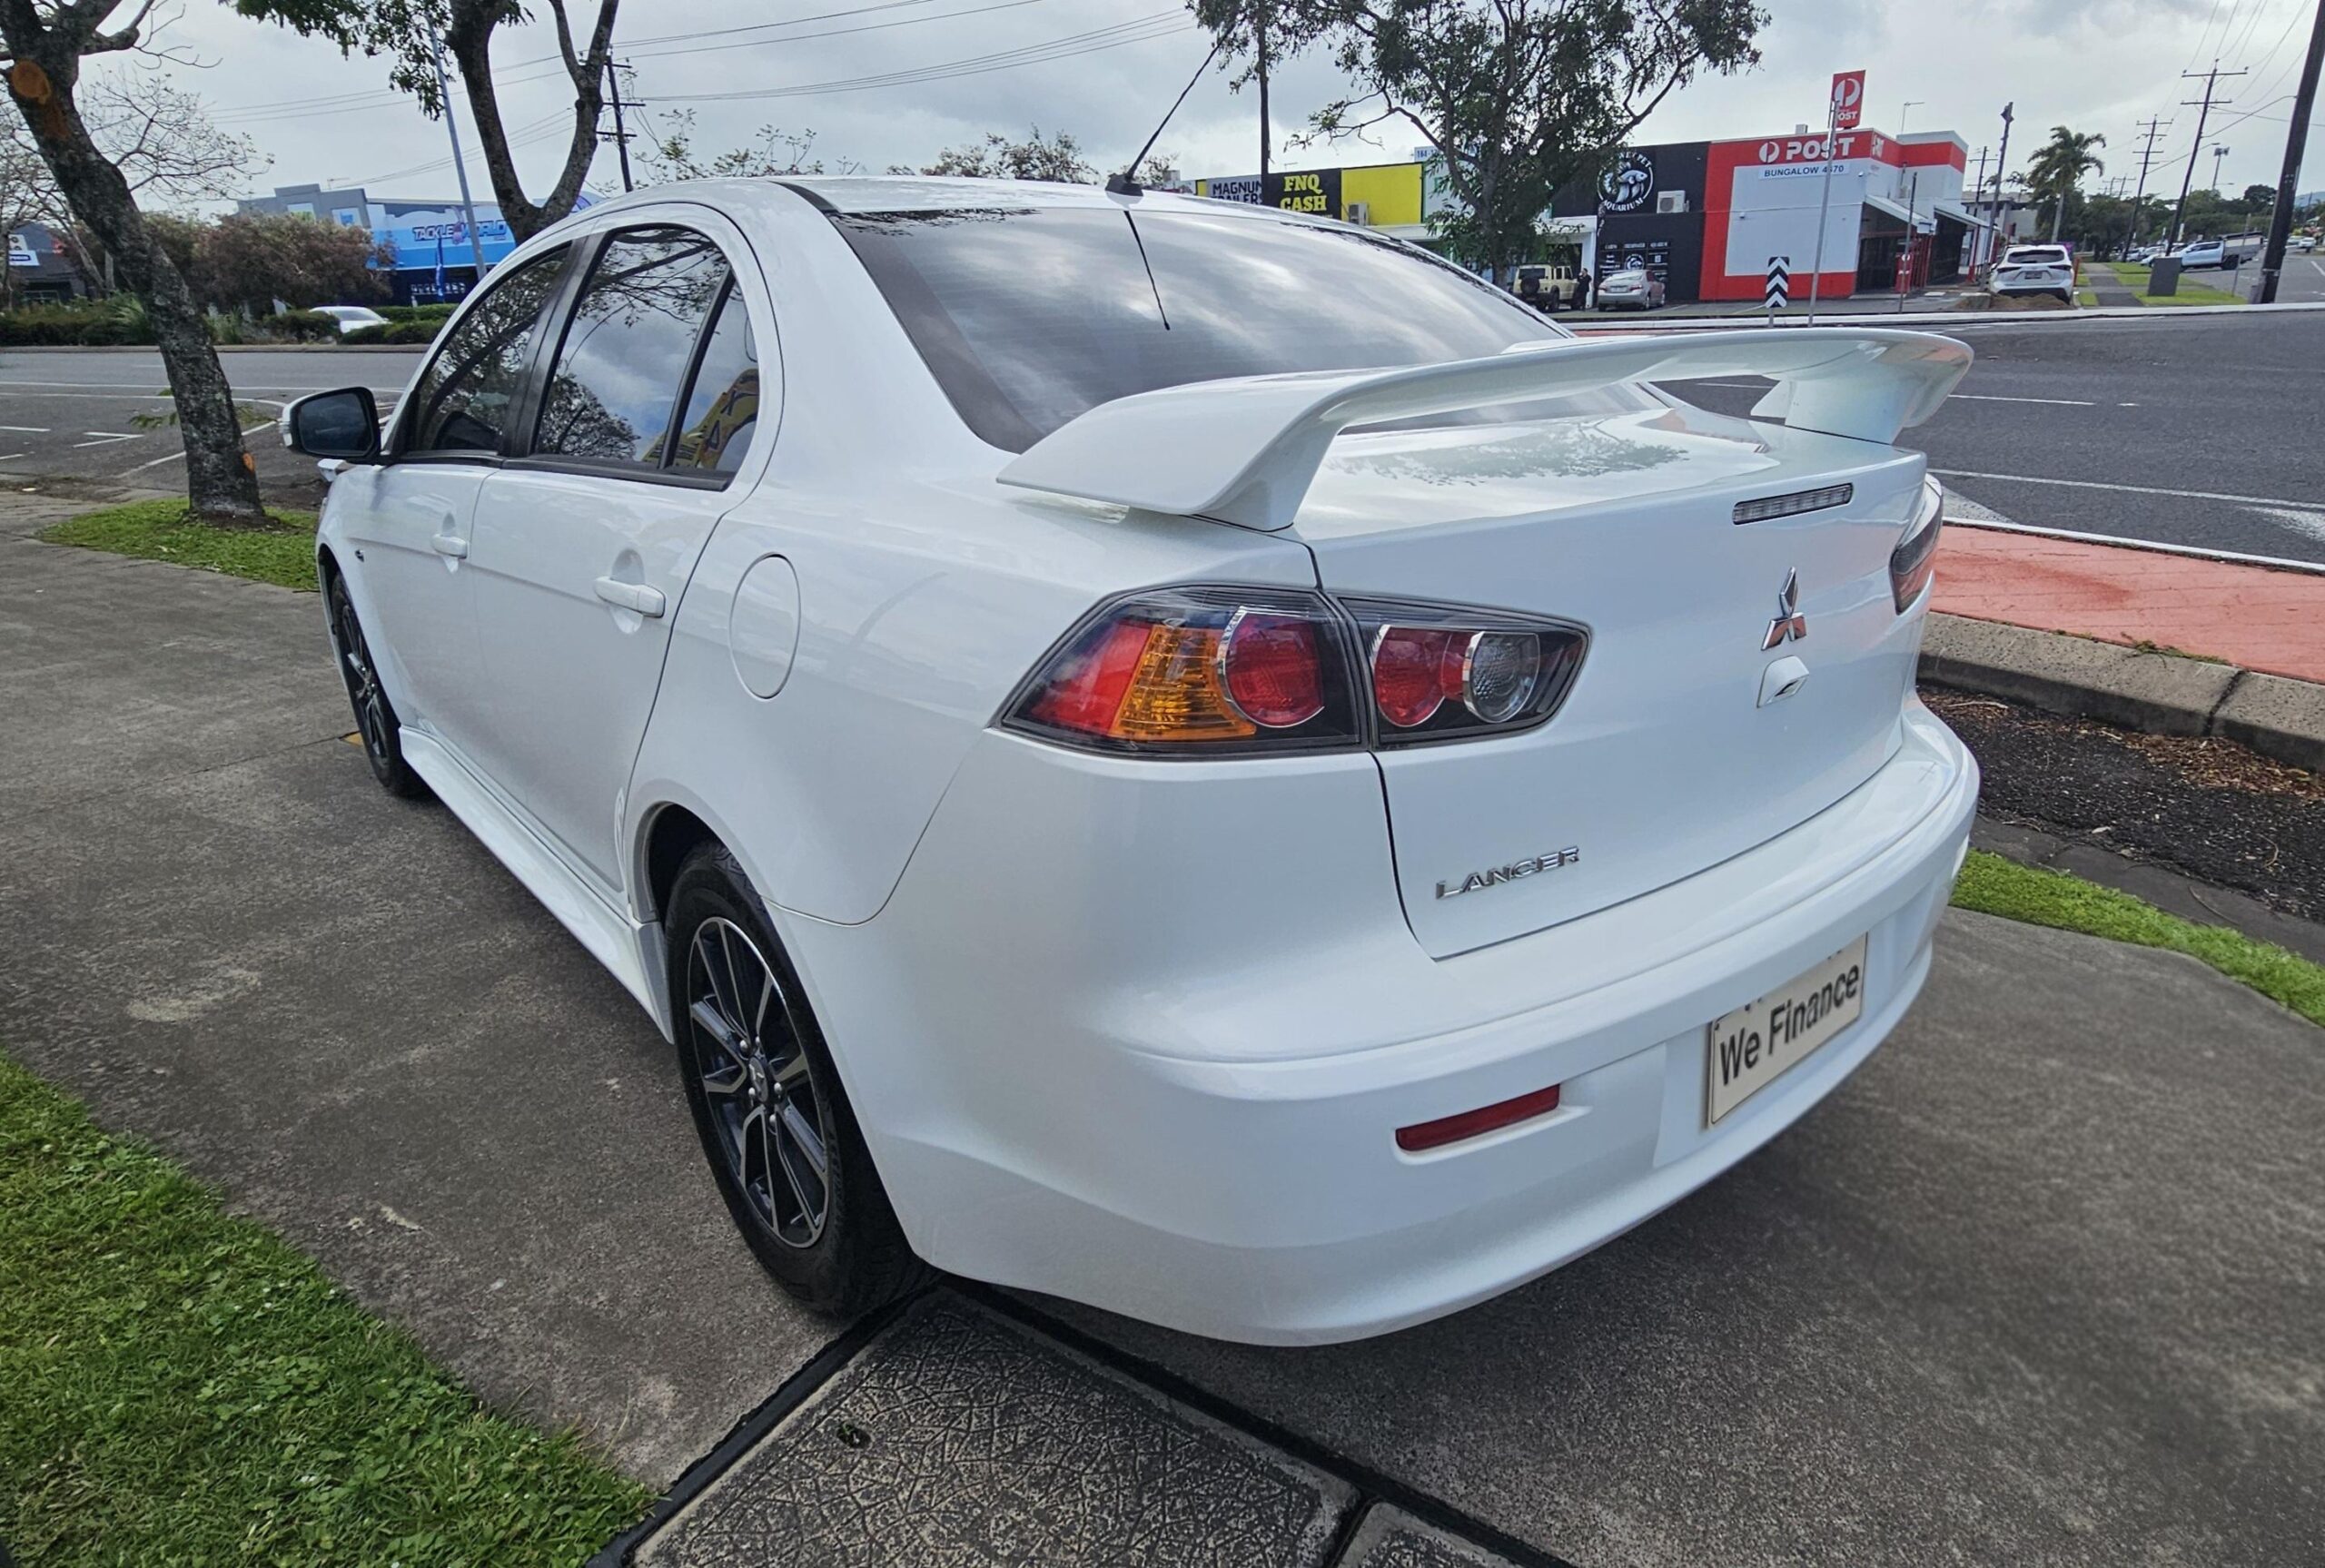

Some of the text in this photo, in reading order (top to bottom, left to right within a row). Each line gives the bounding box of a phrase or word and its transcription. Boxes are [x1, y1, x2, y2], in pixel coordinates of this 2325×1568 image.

[1838, 111, 1858, 121] OST
[1786, 137, 1855, 161] POST
[1764, 165, 1845, 177] BUNGALOW 470
[1283, 173, 1323, 194] FNQ
[1280, 194, 1328, 212] CASH
[1603, 197, 1644, 212] AQUARIUM
[413, 224, 454, 242] TACKLE
[1436, 846, 1579, 900] LANCER
[1719, 964, 1860, 1087] We Finance
